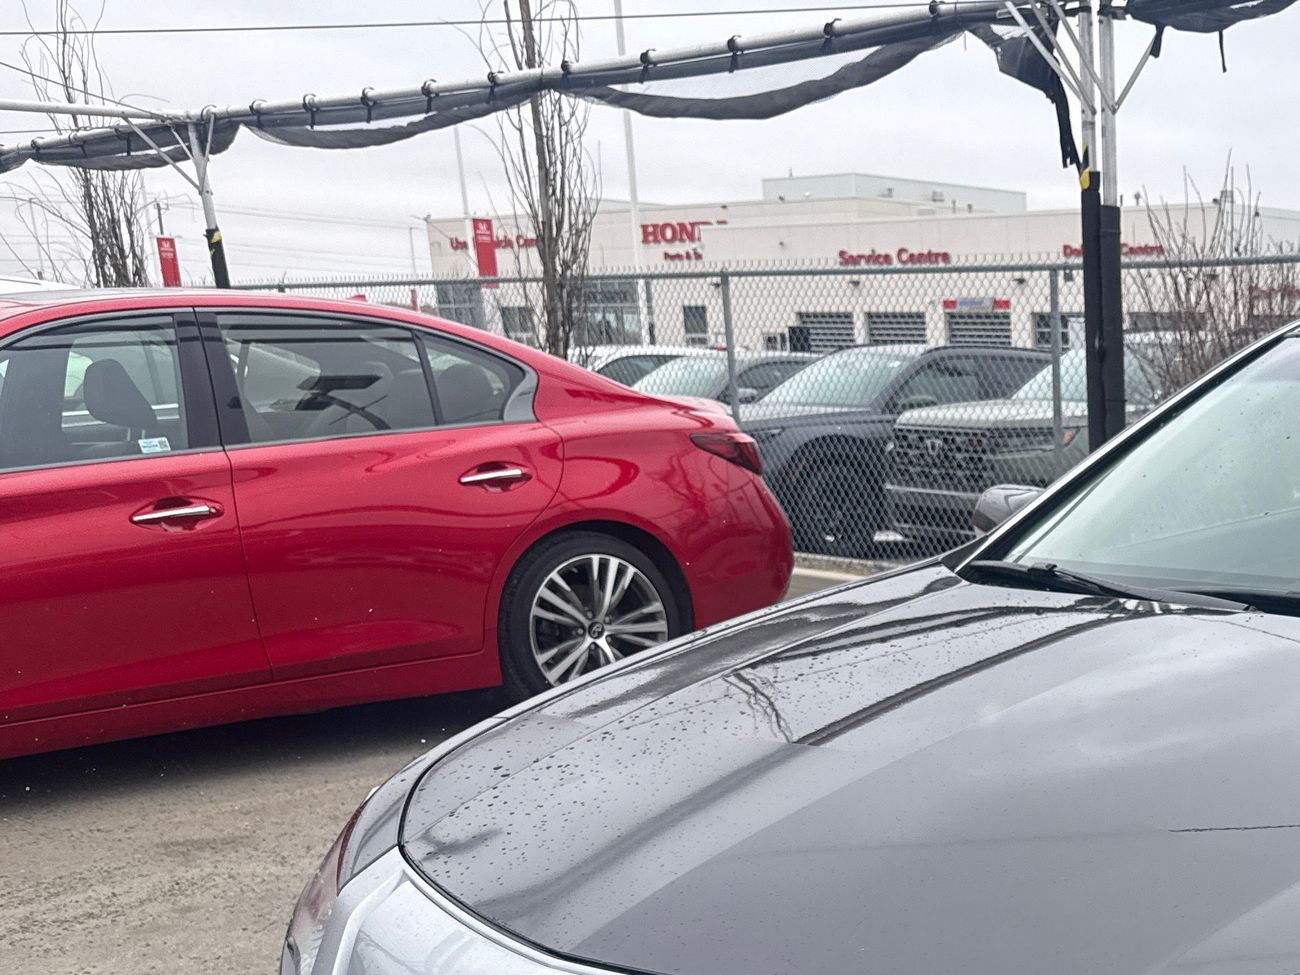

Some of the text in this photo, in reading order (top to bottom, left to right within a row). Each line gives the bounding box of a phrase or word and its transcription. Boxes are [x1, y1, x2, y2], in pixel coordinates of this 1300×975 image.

[640, 221, 727, 245] HON
[838, 247, 951, 266] Service Centre
